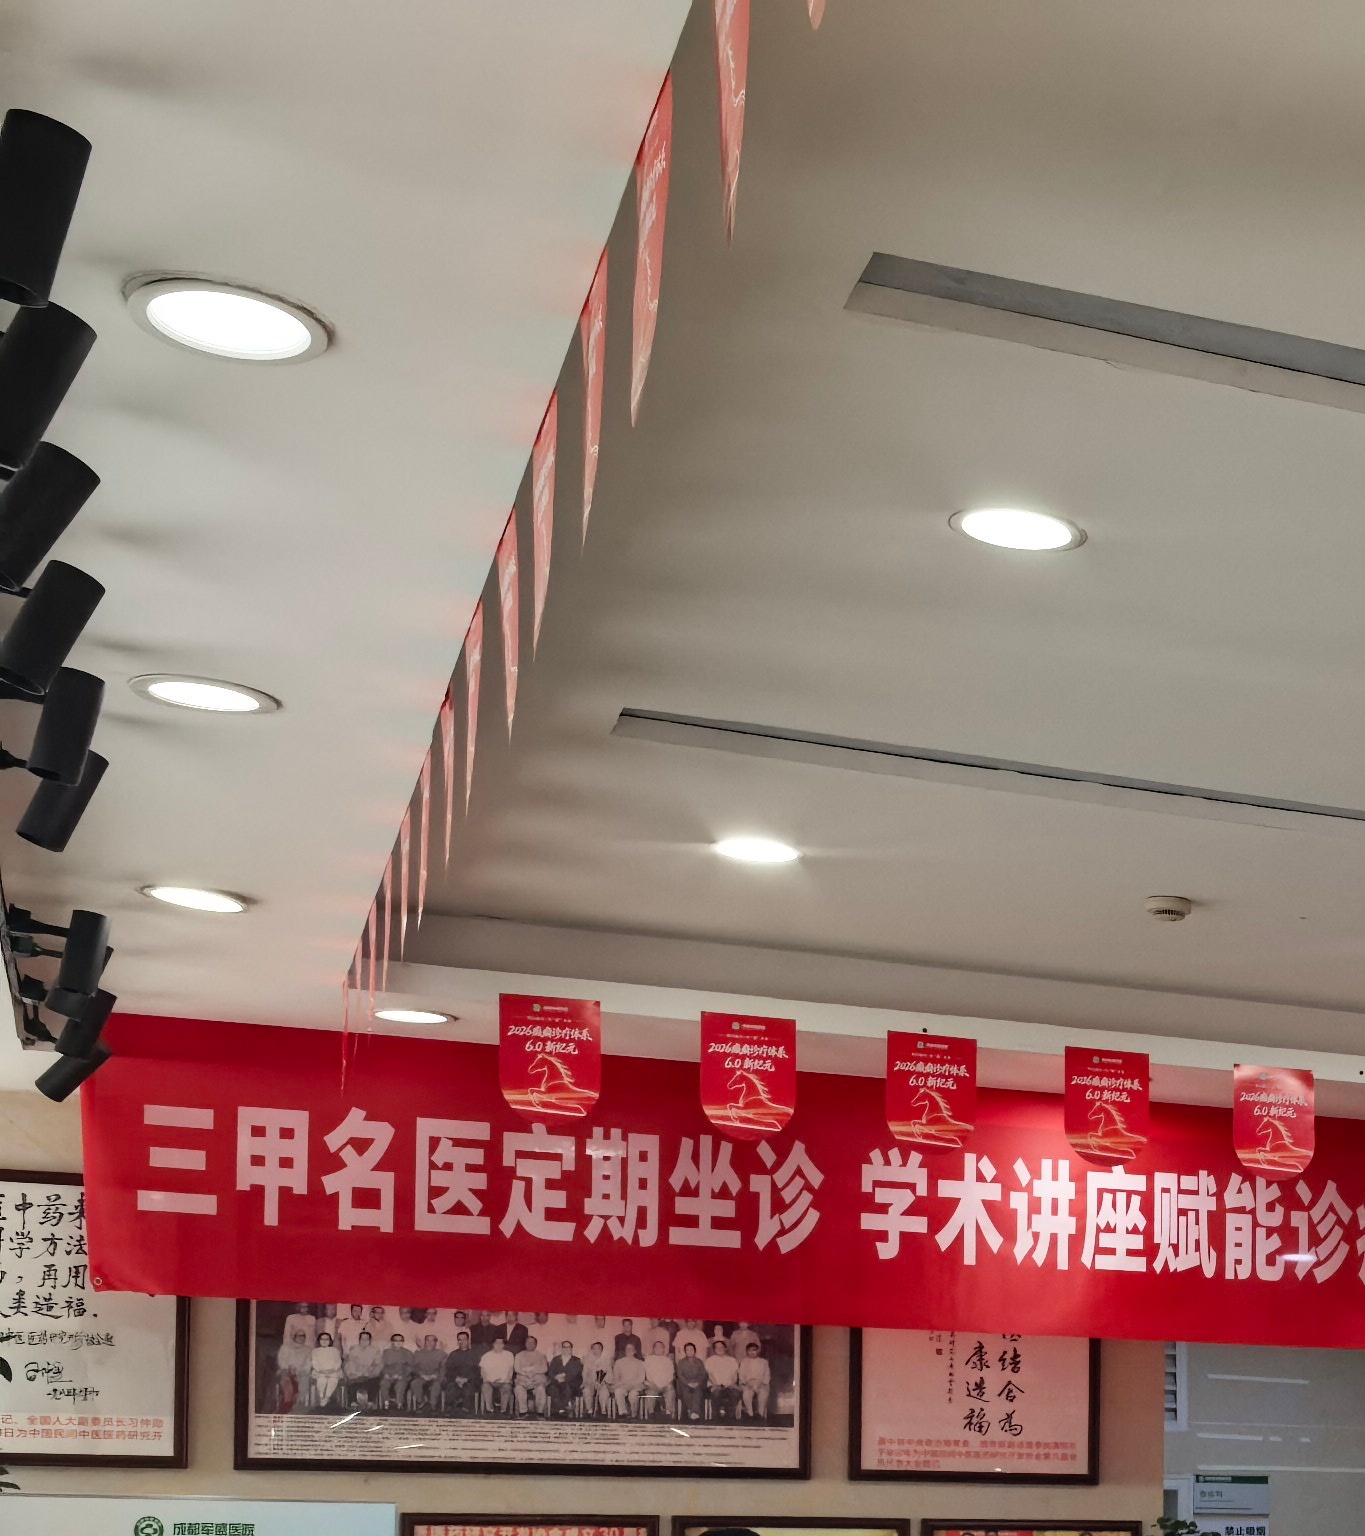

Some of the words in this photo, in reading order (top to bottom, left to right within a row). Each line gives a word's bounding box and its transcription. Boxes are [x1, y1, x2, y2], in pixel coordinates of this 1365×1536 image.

[136, 1103, 825, 1256] 三甲名医定期坐诊
